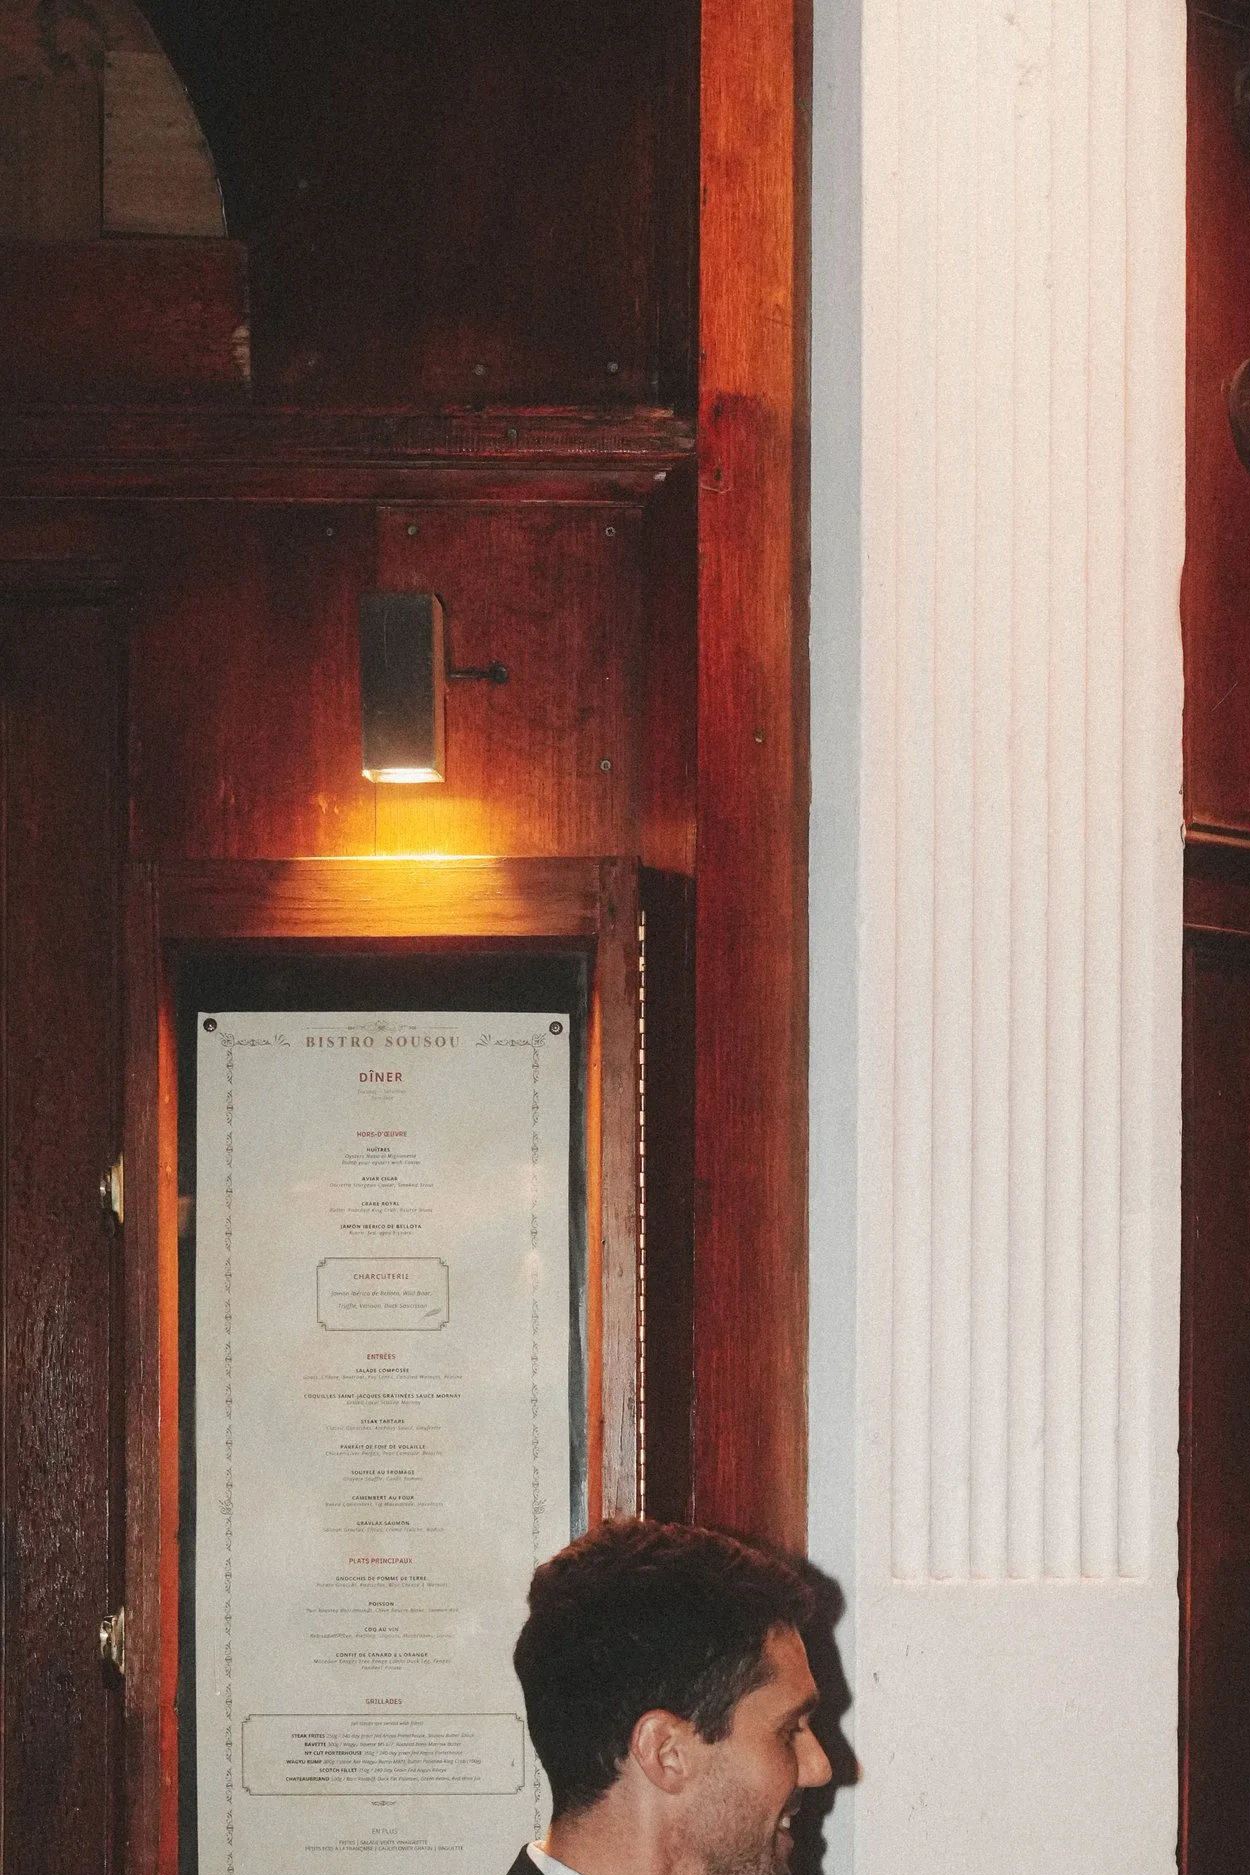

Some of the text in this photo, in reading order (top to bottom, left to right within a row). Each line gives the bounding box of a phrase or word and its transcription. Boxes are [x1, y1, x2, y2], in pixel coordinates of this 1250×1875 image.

[306, 1036, 460, 1048] BISTRO SOUSOU
[360, 1069, 402, 1082] DÎNER
